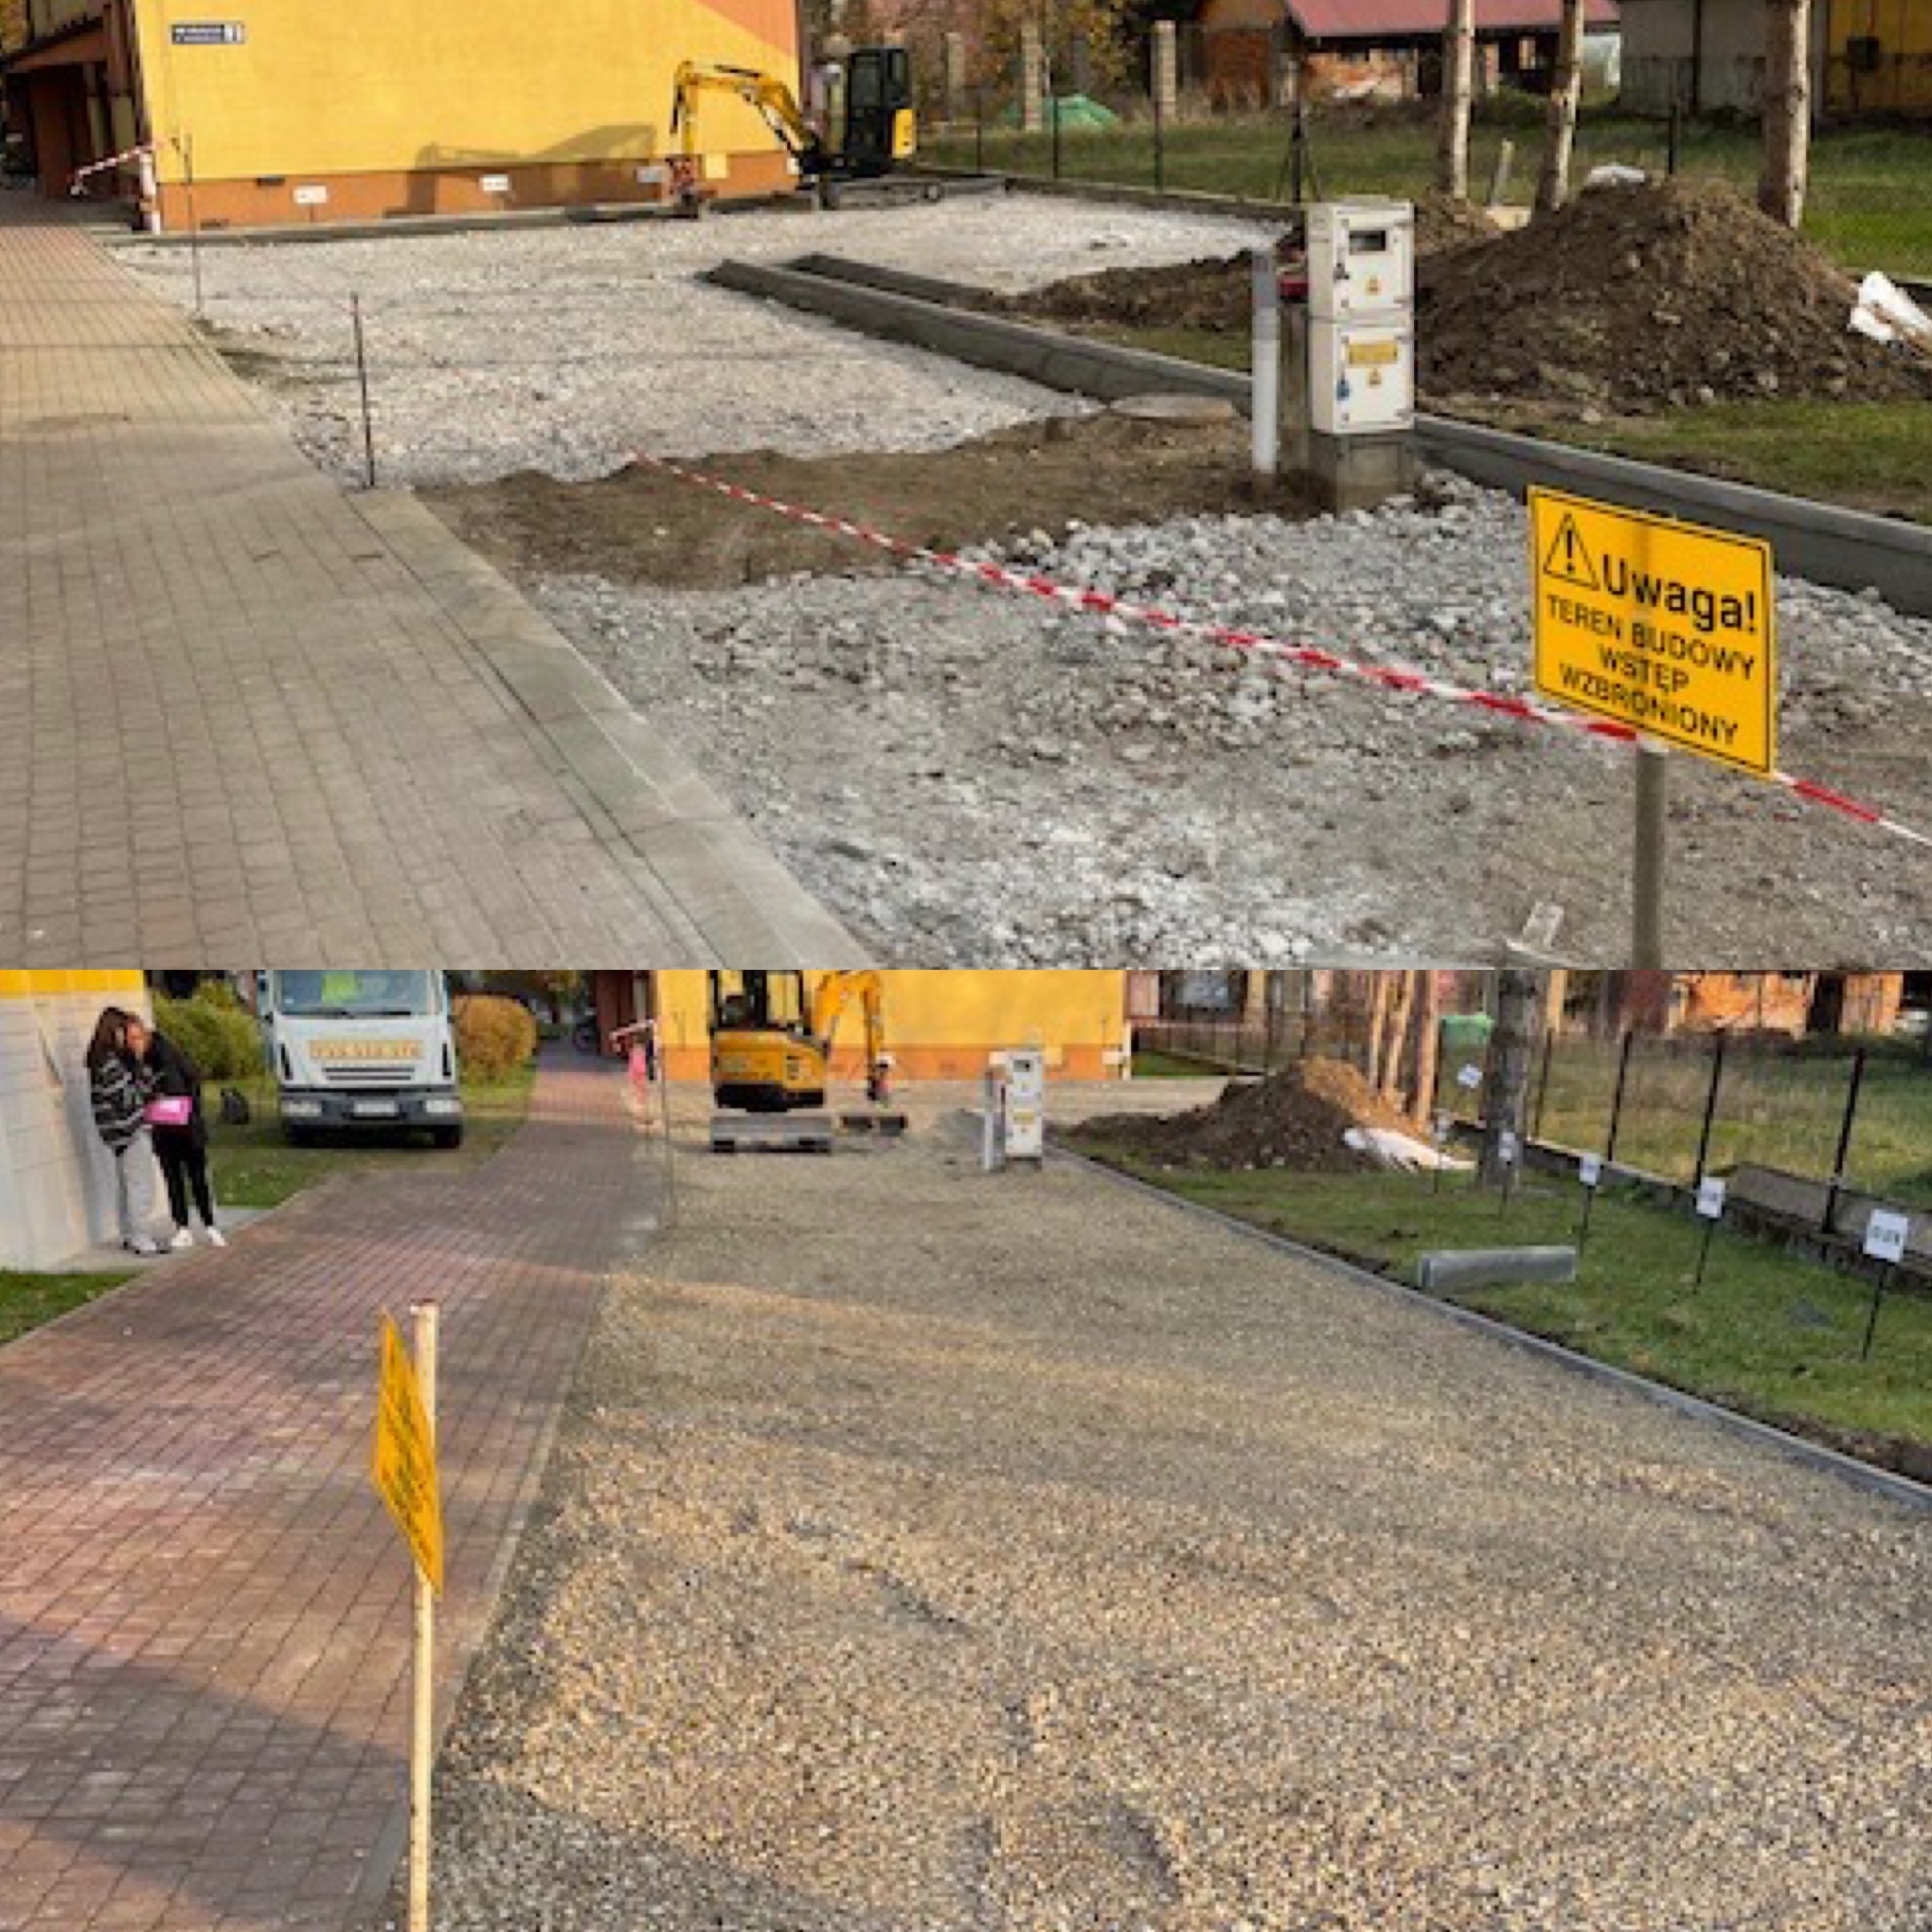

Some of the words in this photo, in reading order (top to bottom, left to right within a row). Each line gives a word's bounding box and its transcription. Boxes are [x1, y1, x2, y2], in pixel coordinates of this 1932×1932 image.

[1602, 553, 1756, 635] Uwaga!
[1547, 594, 1621, 640] TEREN
[1631, 622, 1755, 680] BUDOWY
[1558, 662, 1739, 745] WZBRONIONY
